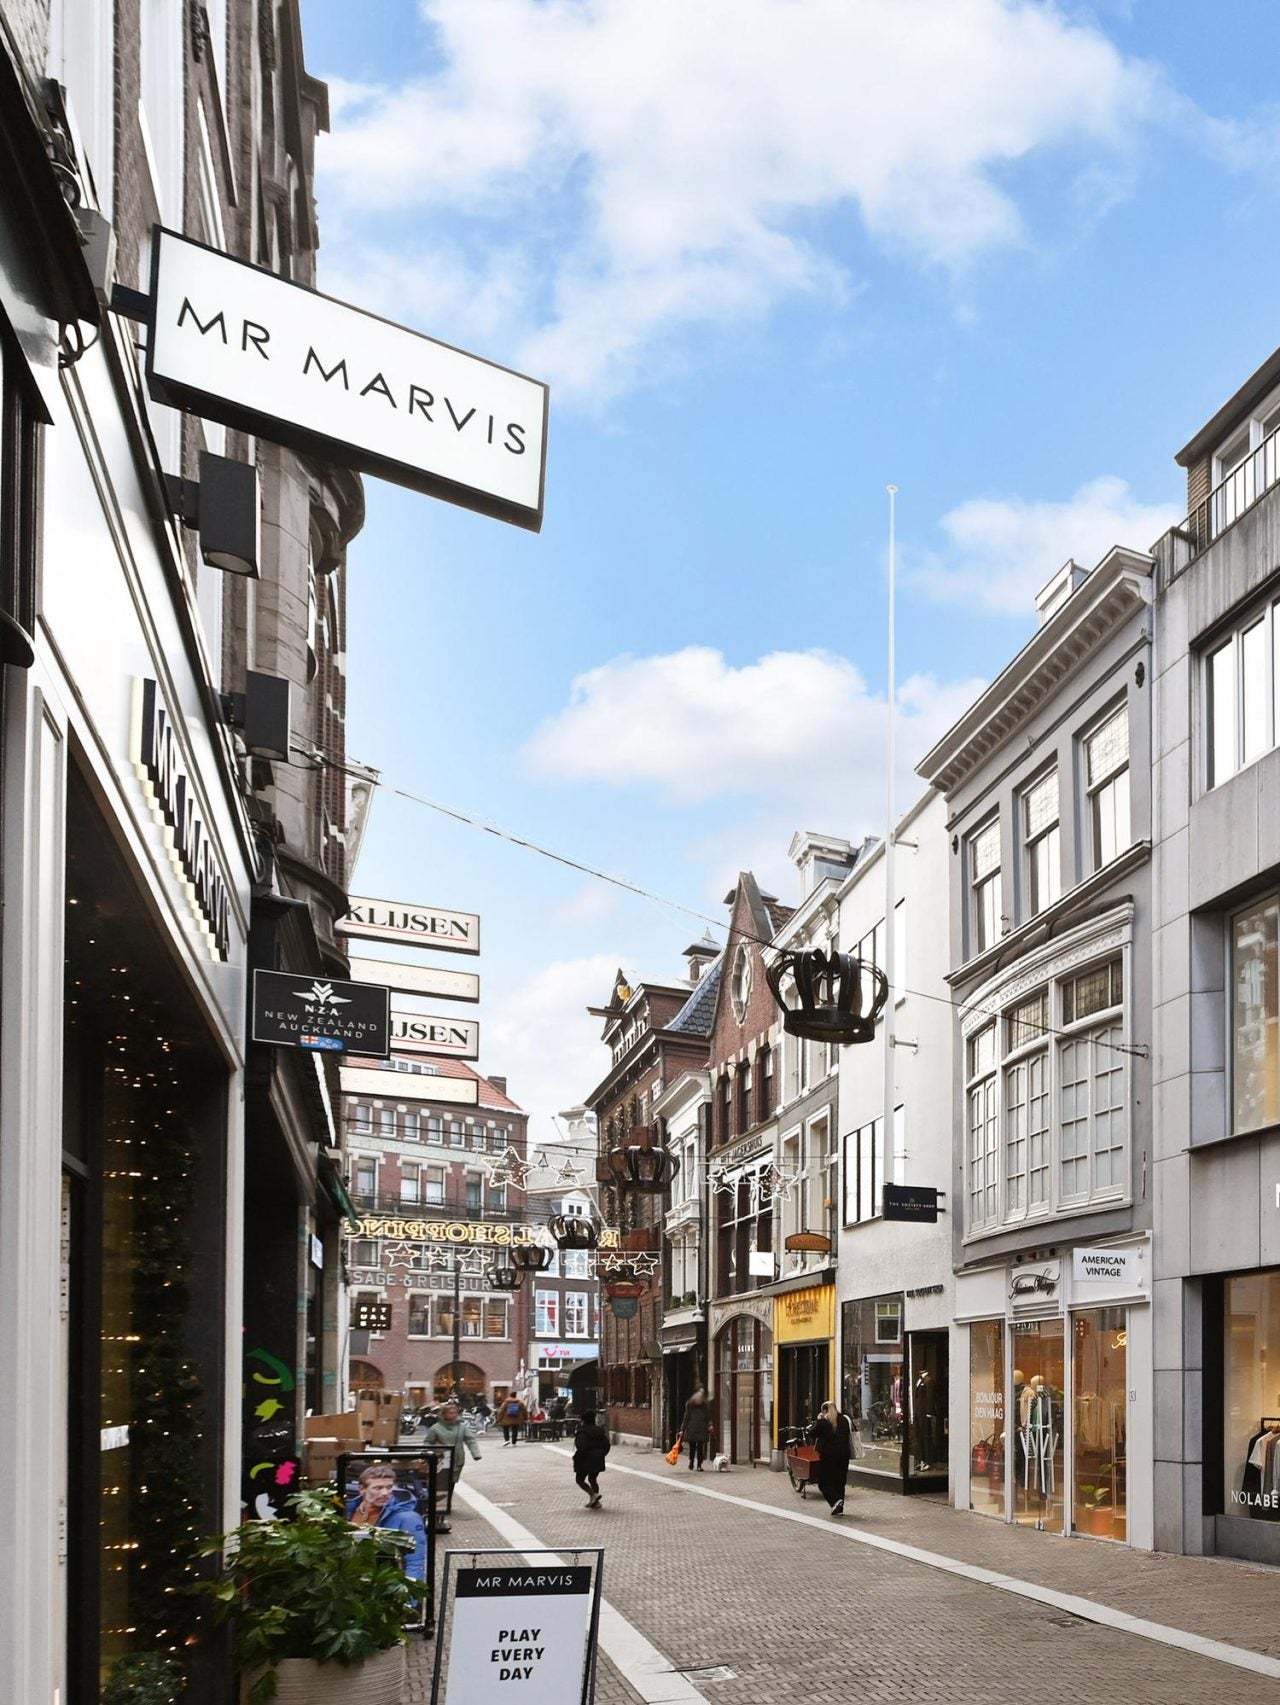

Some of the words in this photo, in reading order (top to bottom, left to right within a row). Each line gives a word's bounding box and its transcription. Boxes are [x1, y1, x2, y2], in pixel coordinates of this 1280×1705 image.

[177, 296, 271, 360] MR
[302, 346, 527, 456] MARVIS
[264, 1010, 298, 1021] NEW
[306, 1016, 378, 1031] ZEALAND
[279, 1022, 363, 1039] AUCKLAND
[1081, 1255, 1126, 1265] AMERICAN
[1086, 1267, 1121, 1276] VINTAGE
[350, 1272, 396, 1286] SAGE
[976, 1392, 1003, 1404] BONJOUR
[476, 1576, 501, 1588] MR
[508, 1575, 573, 1587] MARVIS
[498, 1628, 541, 1643] PLAY
[490, 1647, 545, 1662] EVERY
[499, 1667, 534, 1681] DAY
